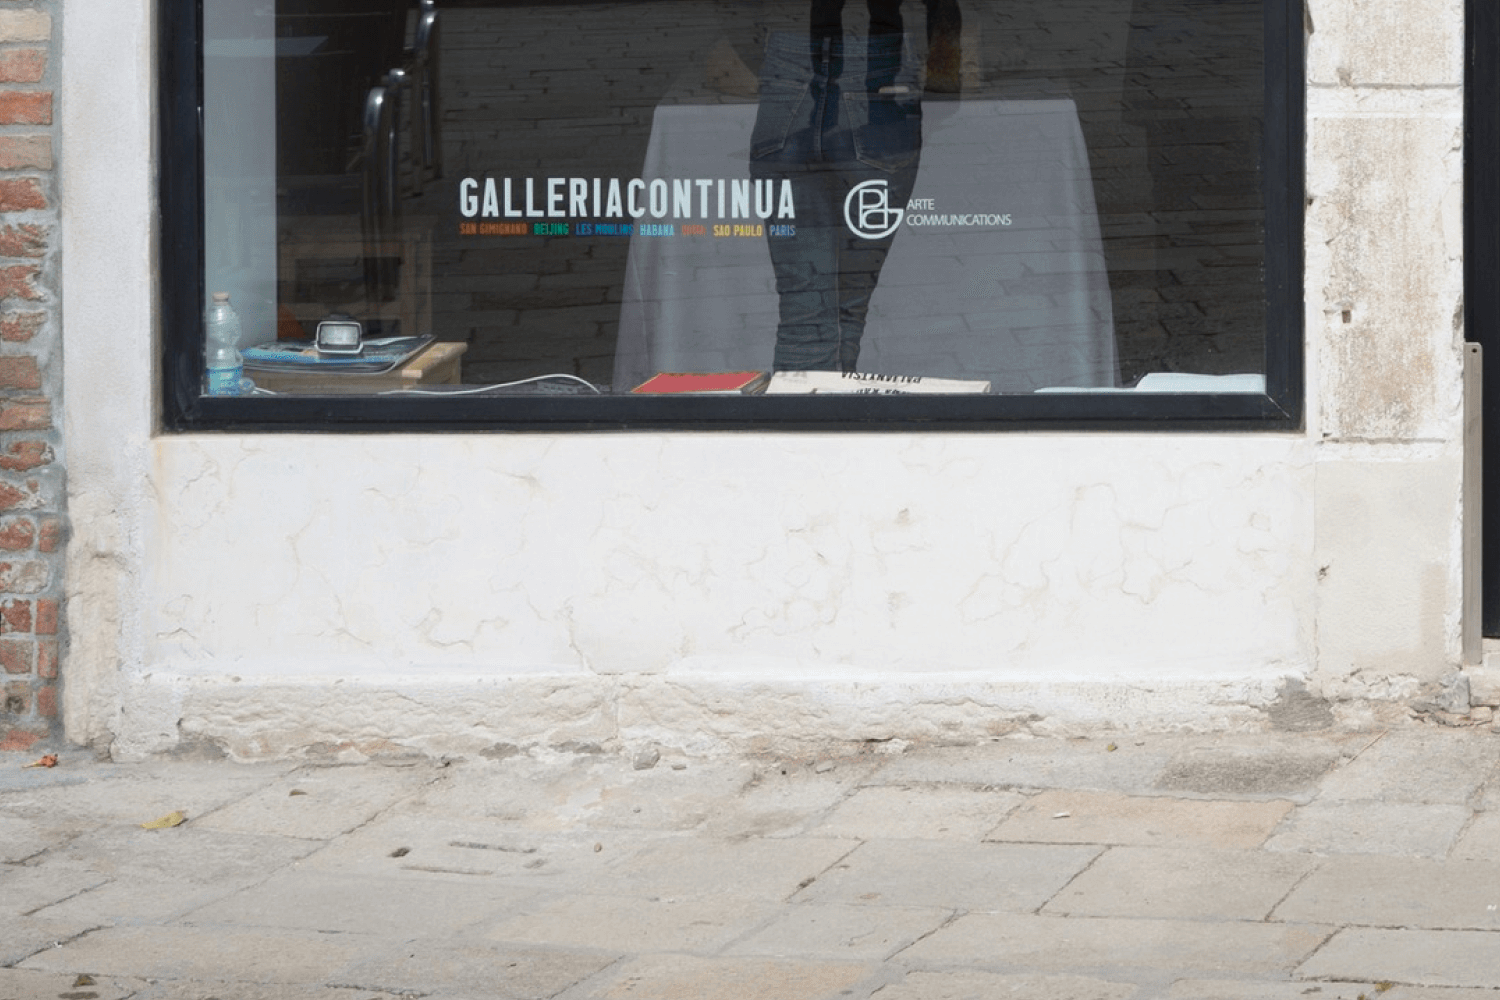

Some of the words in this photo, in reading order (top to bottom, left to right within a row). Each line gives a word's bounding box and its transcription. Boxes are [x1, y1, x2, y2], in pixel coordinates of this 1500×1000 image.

[459, 177, 795, 218] GALLERIACONTINUA
[905, 198, 935, 211] ARTE
[906, 213, 1012, 226] COMMUNICATIONS
[533, 222, 569, 235] BEIJING
[575, 223, 592, 235] LES
[733, 224, 763, 237] PAULO
[769, 224, 796, 237] PARIS
